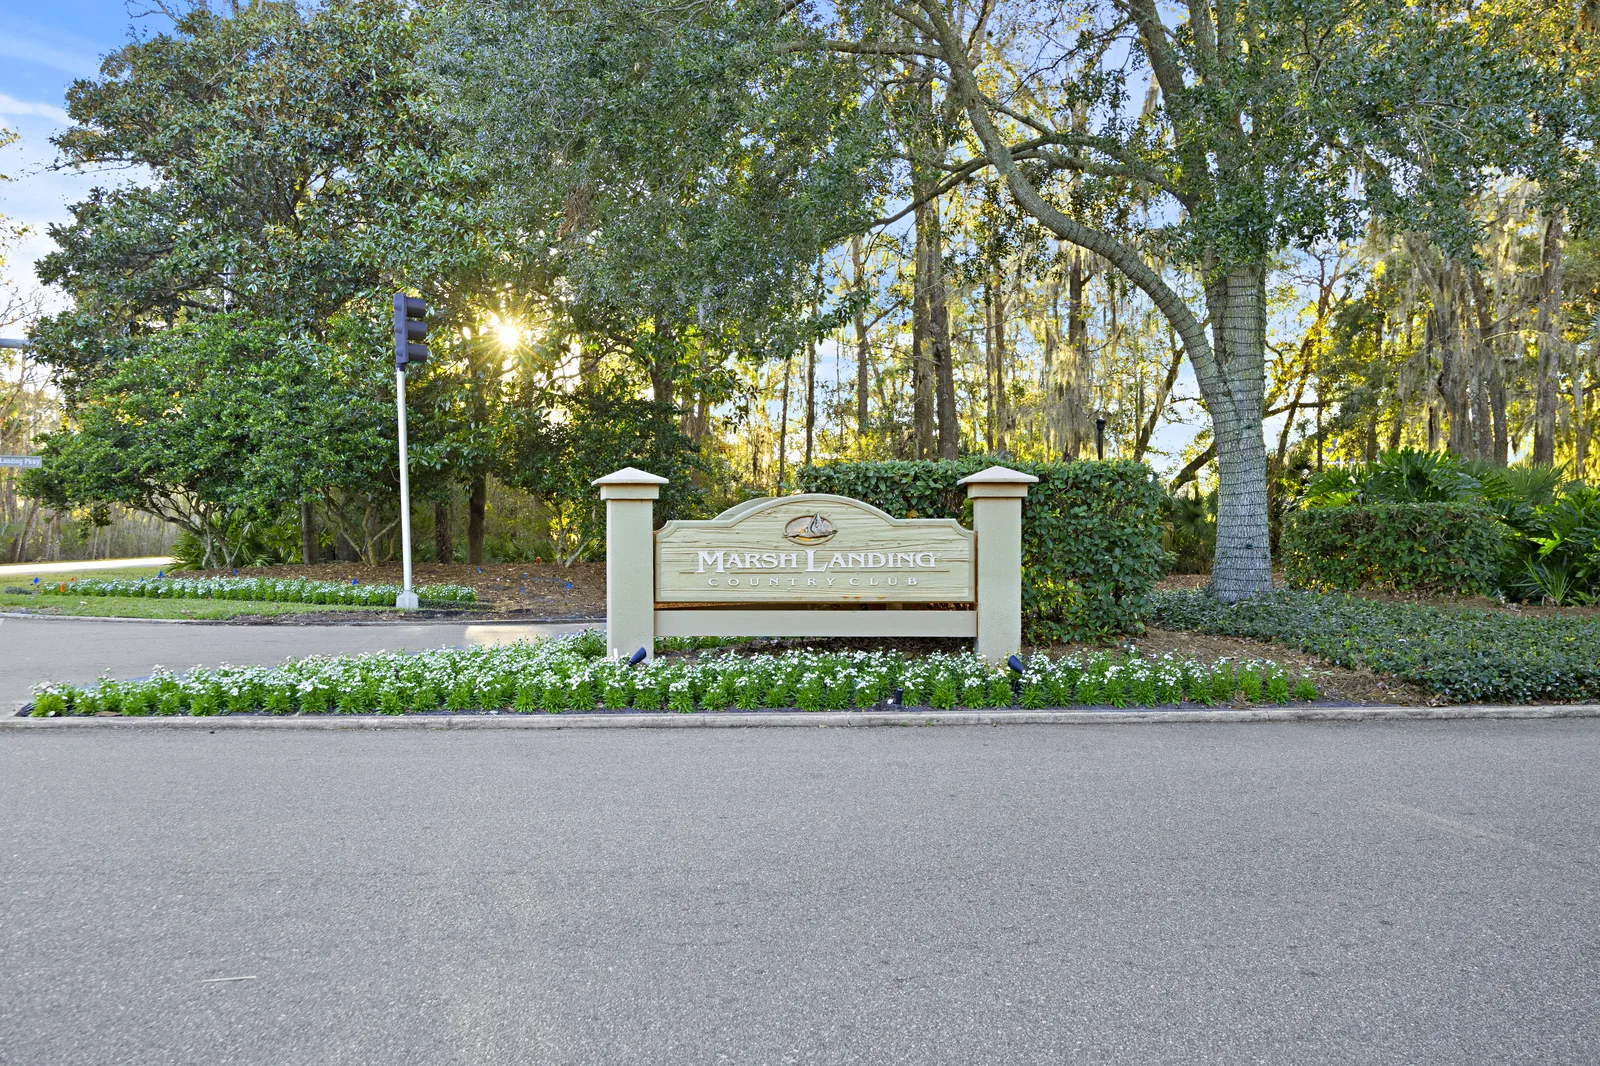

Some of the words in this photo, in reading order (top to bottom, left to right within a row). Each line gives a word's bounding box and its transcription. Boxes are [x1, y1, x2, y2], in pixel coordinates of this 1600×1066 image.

[24, 458, 40, 466] Pkwy
[696, 550, 799, 573] MARSH
[804, 549, 937, 572] LANDING
[708, 577, 836, 586] COUNTRY
[849, 577, 919, 586] CLUB
